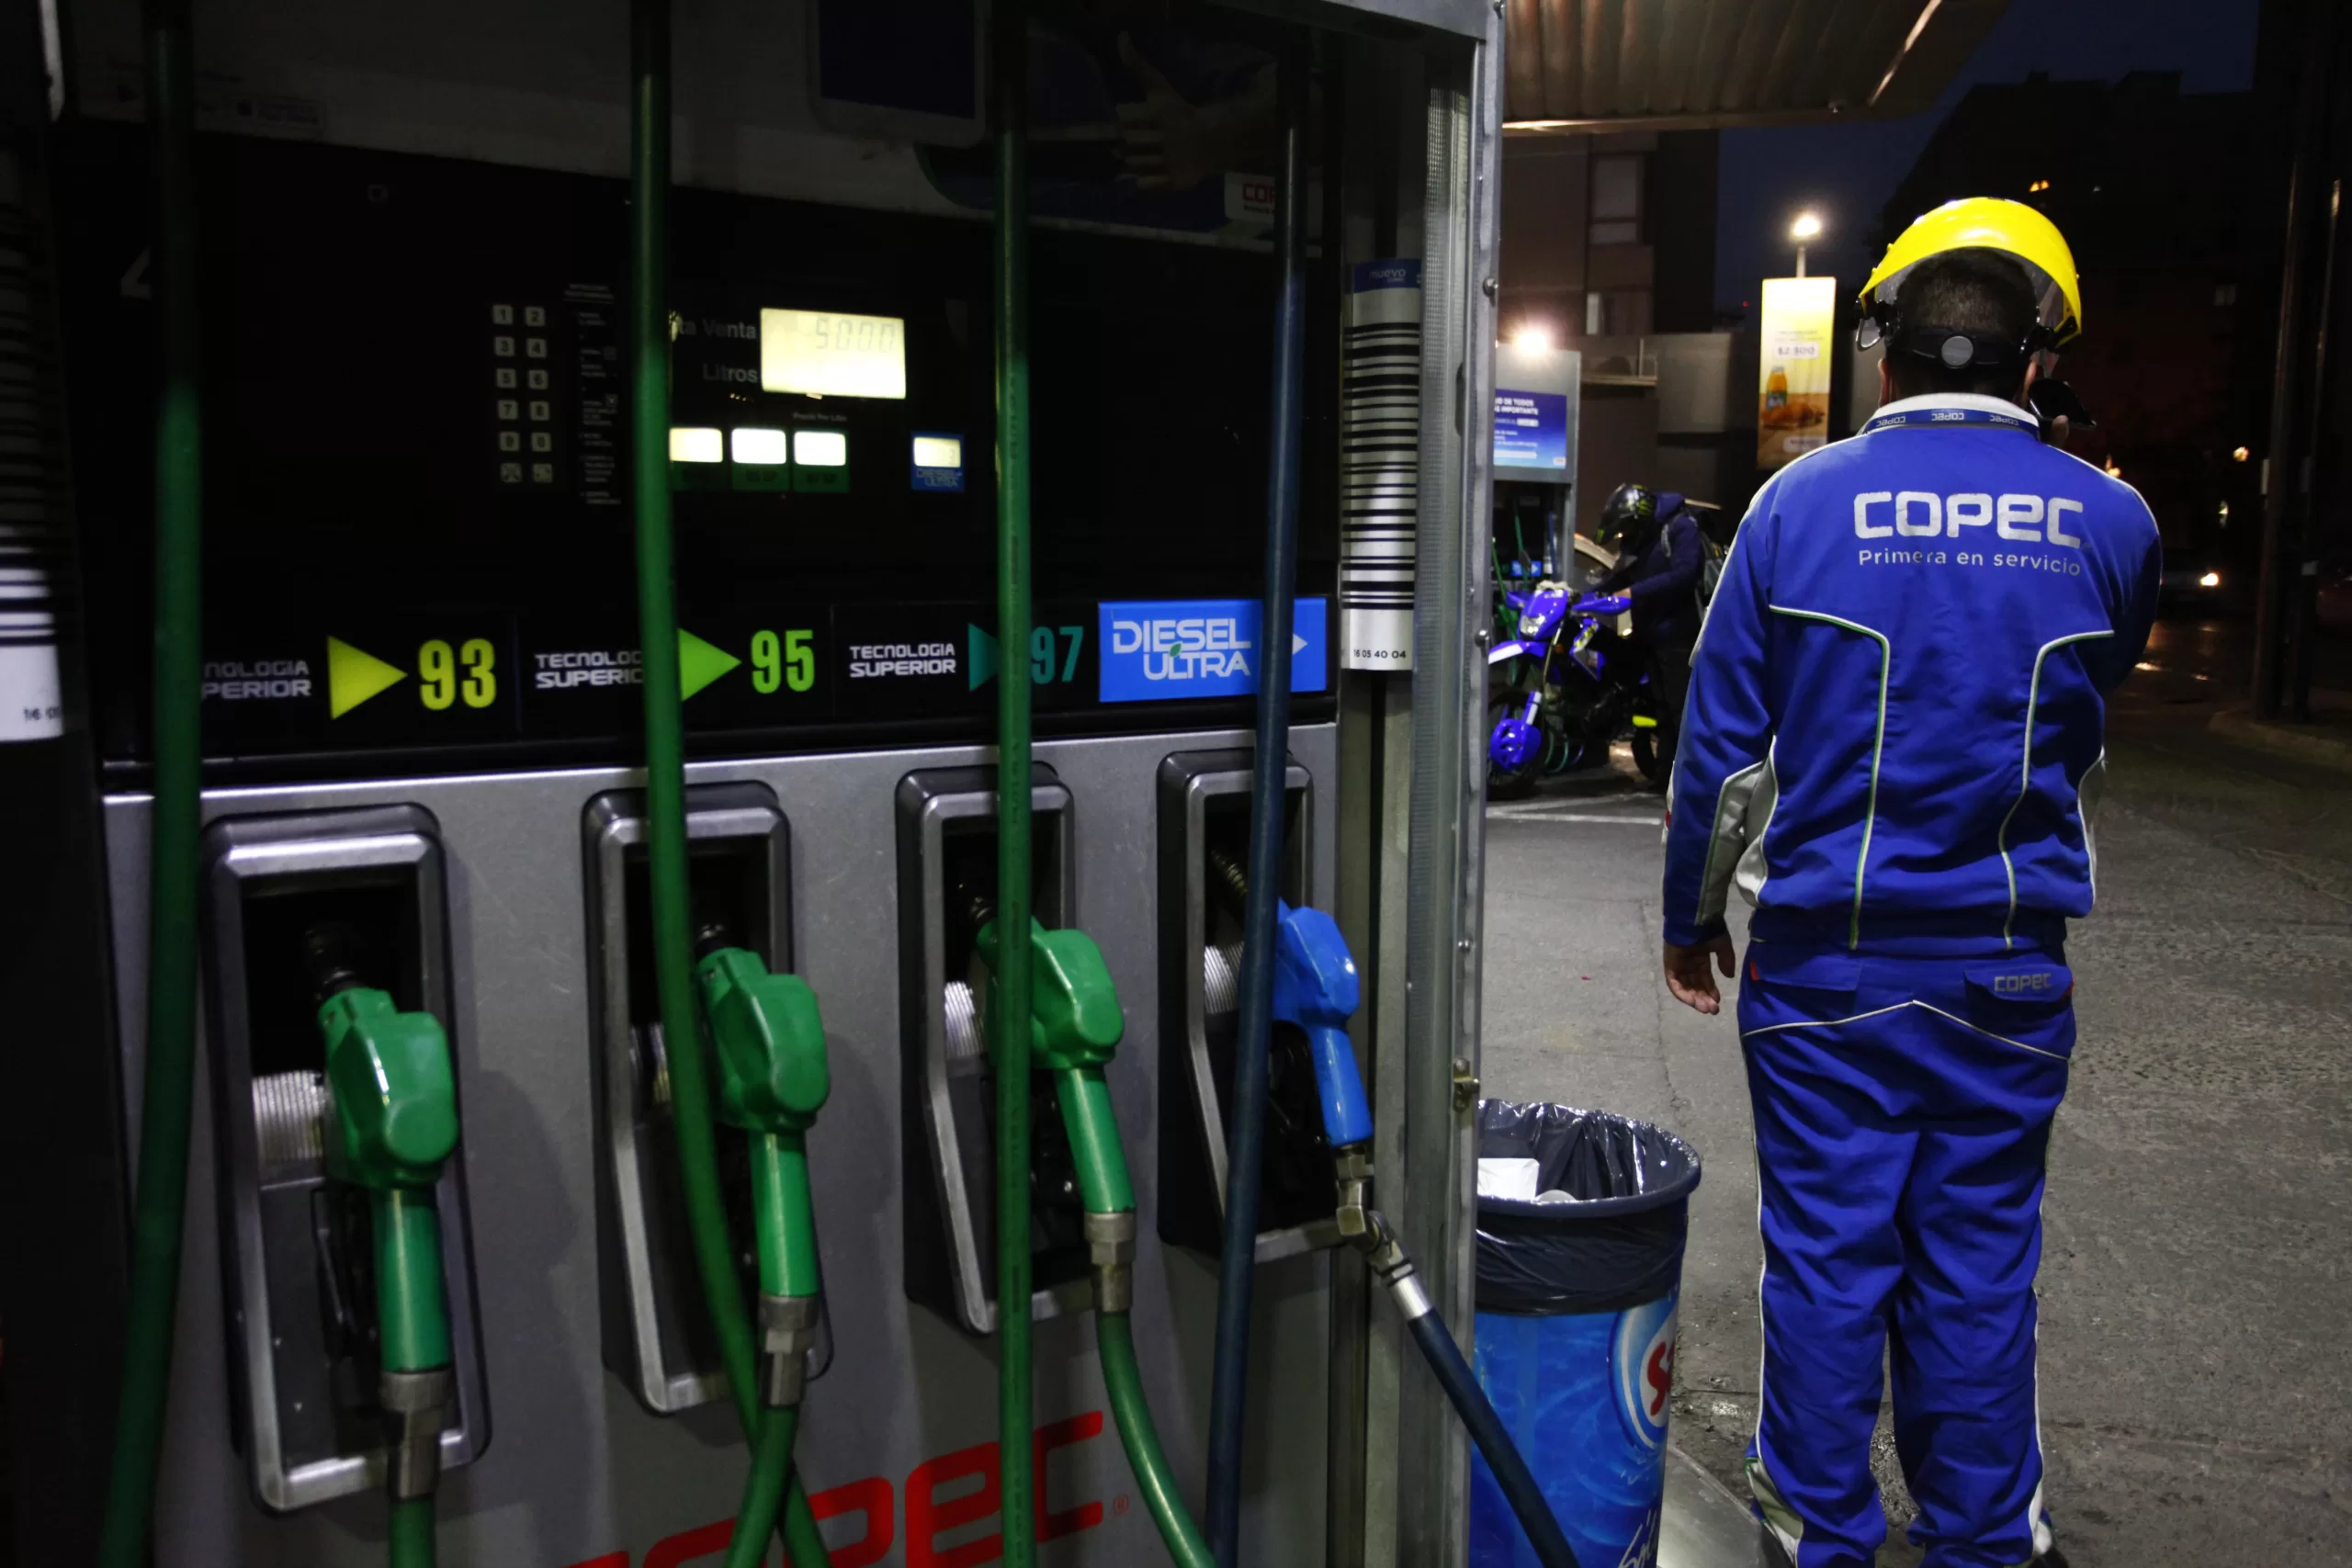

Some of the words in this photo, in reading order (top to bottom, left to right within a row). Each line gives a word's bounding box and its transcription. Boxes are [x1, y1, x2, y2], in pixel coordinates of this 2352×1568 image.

[702, 318, 757, 339] Venta
[703, 363, 759, 383] Litros
[1931, 412, 1965, 422] COPEC
[1853, 491, 2084, 549] COPEC
[1859, 548, 1947, 566] Primera
[1956, 552, 1984, 567] en
[1993, 552, 2081, 576] servicio
[1113, 618, 1252, 654] DIESEL
[750, 627, 817, 694] 95
[849, 642, 956, 660] TECNOLOGIA
[1031, 626, 1085, 685] 97
[1362, 649, 1372, 659] 05
[1374, 650, 1388, 659] 40
[1391, 650, 1407, 660] 04
[416, 637, 498, 712] 93
[849, 659, 957, 679] SUPERIOR
[1143, 649, 1252, 681] ULTRA
[201, 680, 312, 701] PERIOR
[1994, 973, 2053, 993] COPEC
